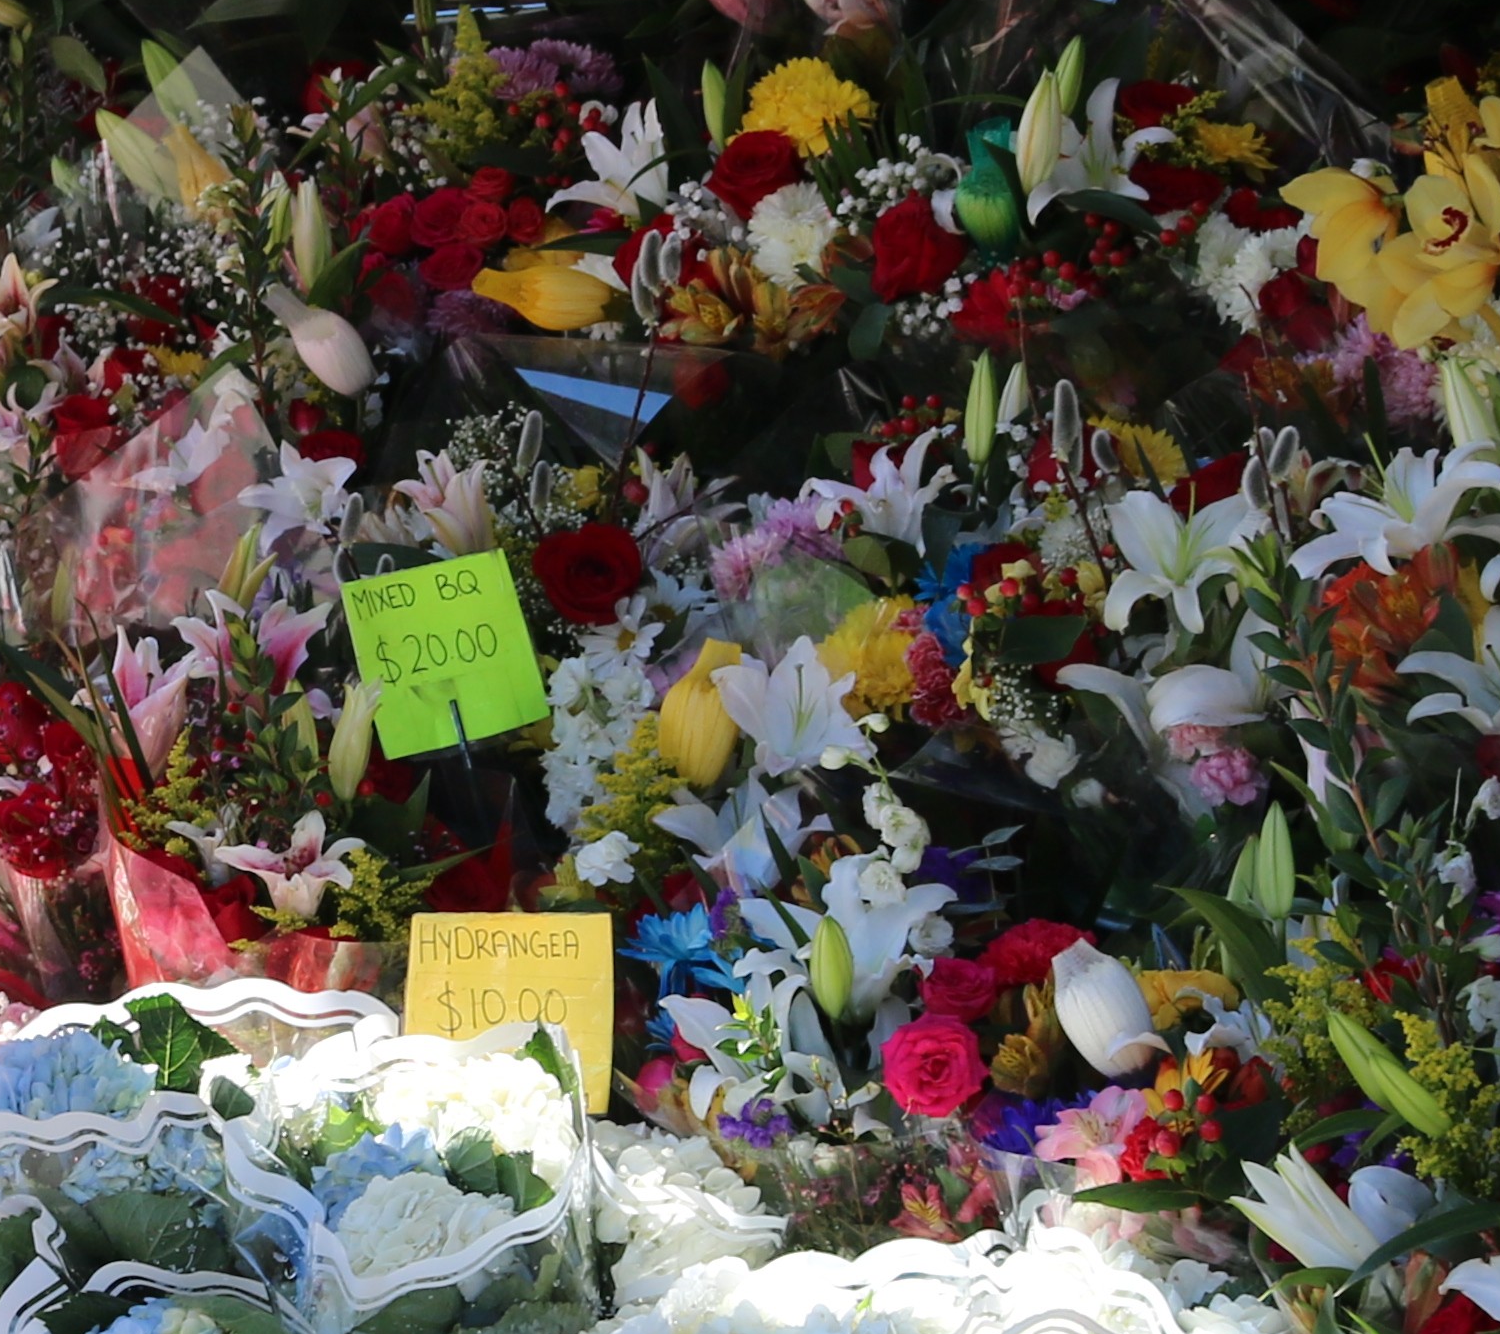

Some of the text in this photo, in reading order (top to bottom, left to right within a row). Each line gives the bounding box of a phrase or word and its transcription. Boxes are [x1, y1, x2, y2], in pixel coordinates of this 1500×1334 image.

[351, 583, 416, 620] MIXED
[376, 623, 498, 686] $20.00
[419, 923, 580, 965] HYDRANGEA
[437, 981, 568, 1038] $10.00
